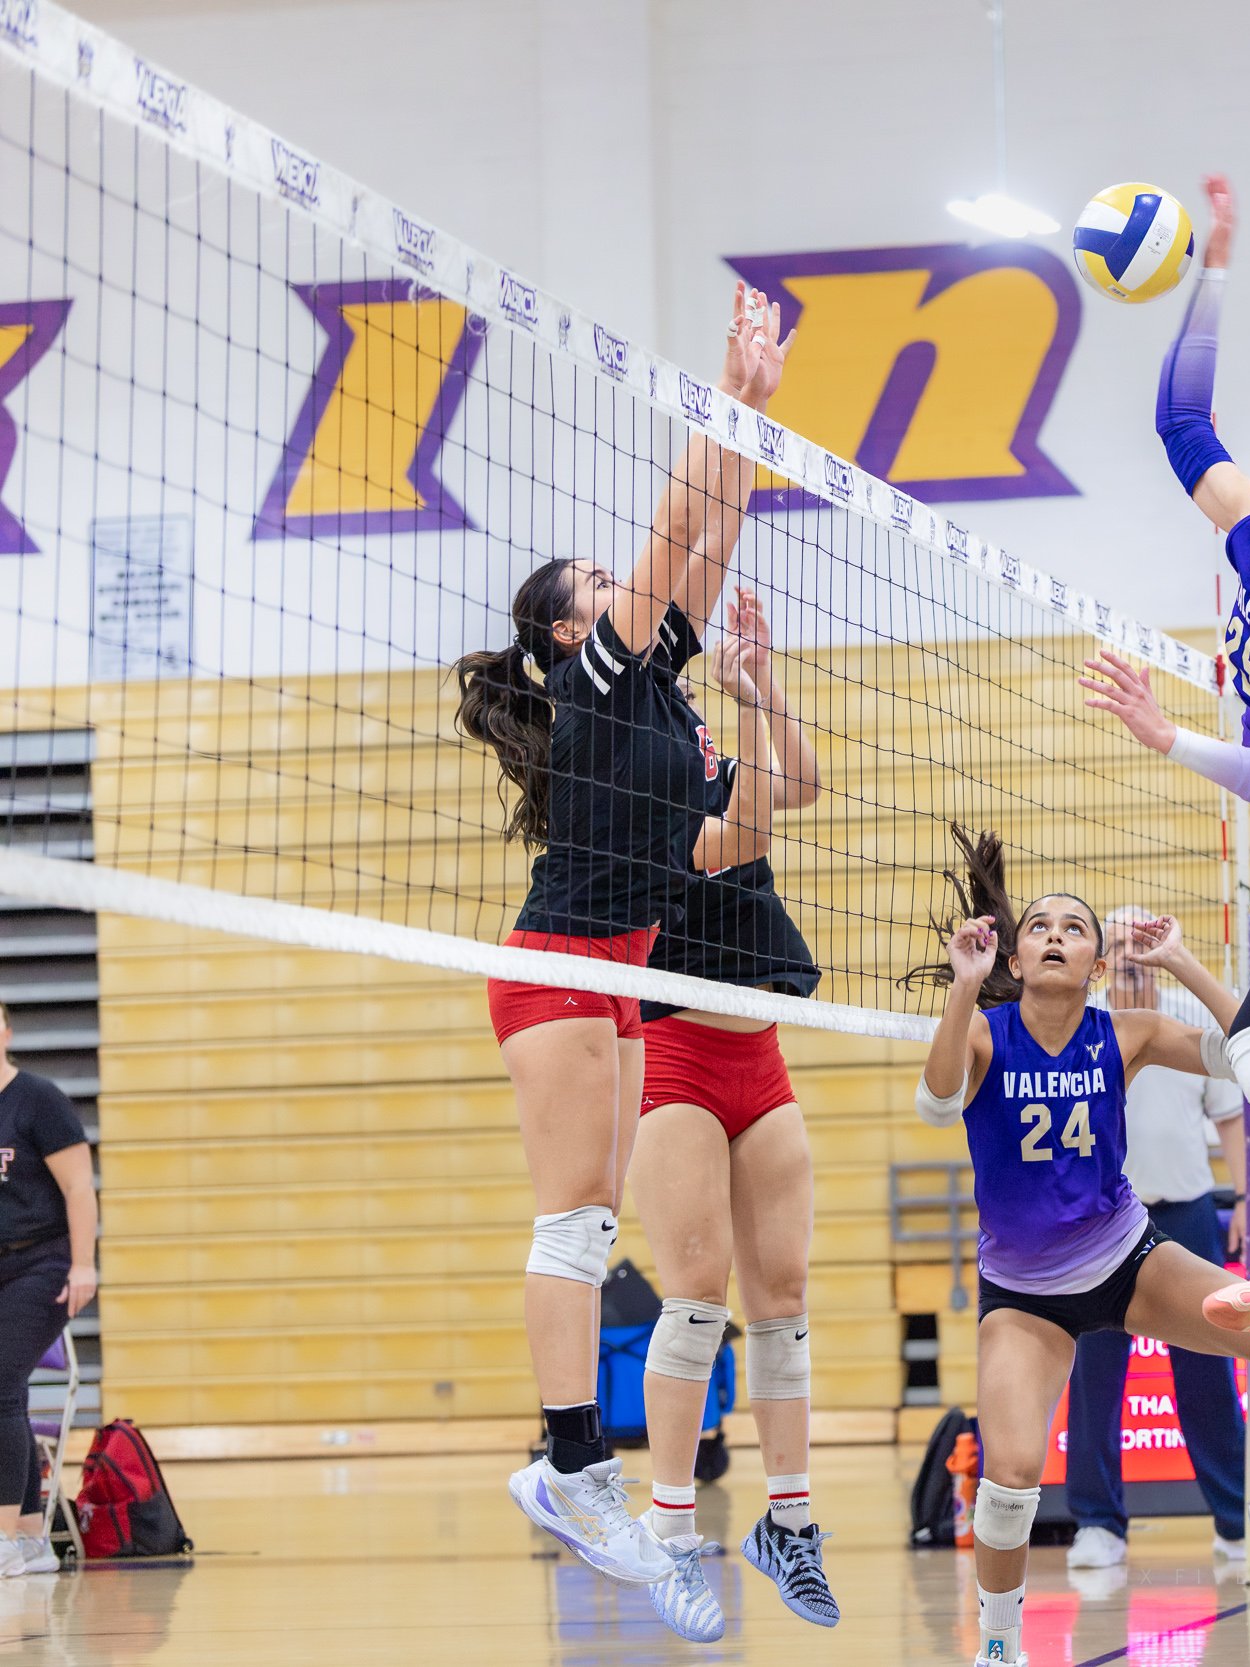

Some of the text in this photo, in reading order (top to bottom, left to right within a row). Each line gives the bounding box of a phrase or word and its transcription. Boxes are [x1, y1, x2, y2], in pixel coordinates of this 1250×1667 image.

[1003, 1067, 1106, 1098] VALENCIA
[1020, 1100, 1096, 1162] 24
[1127, 1395, 1177, 1417] THA
